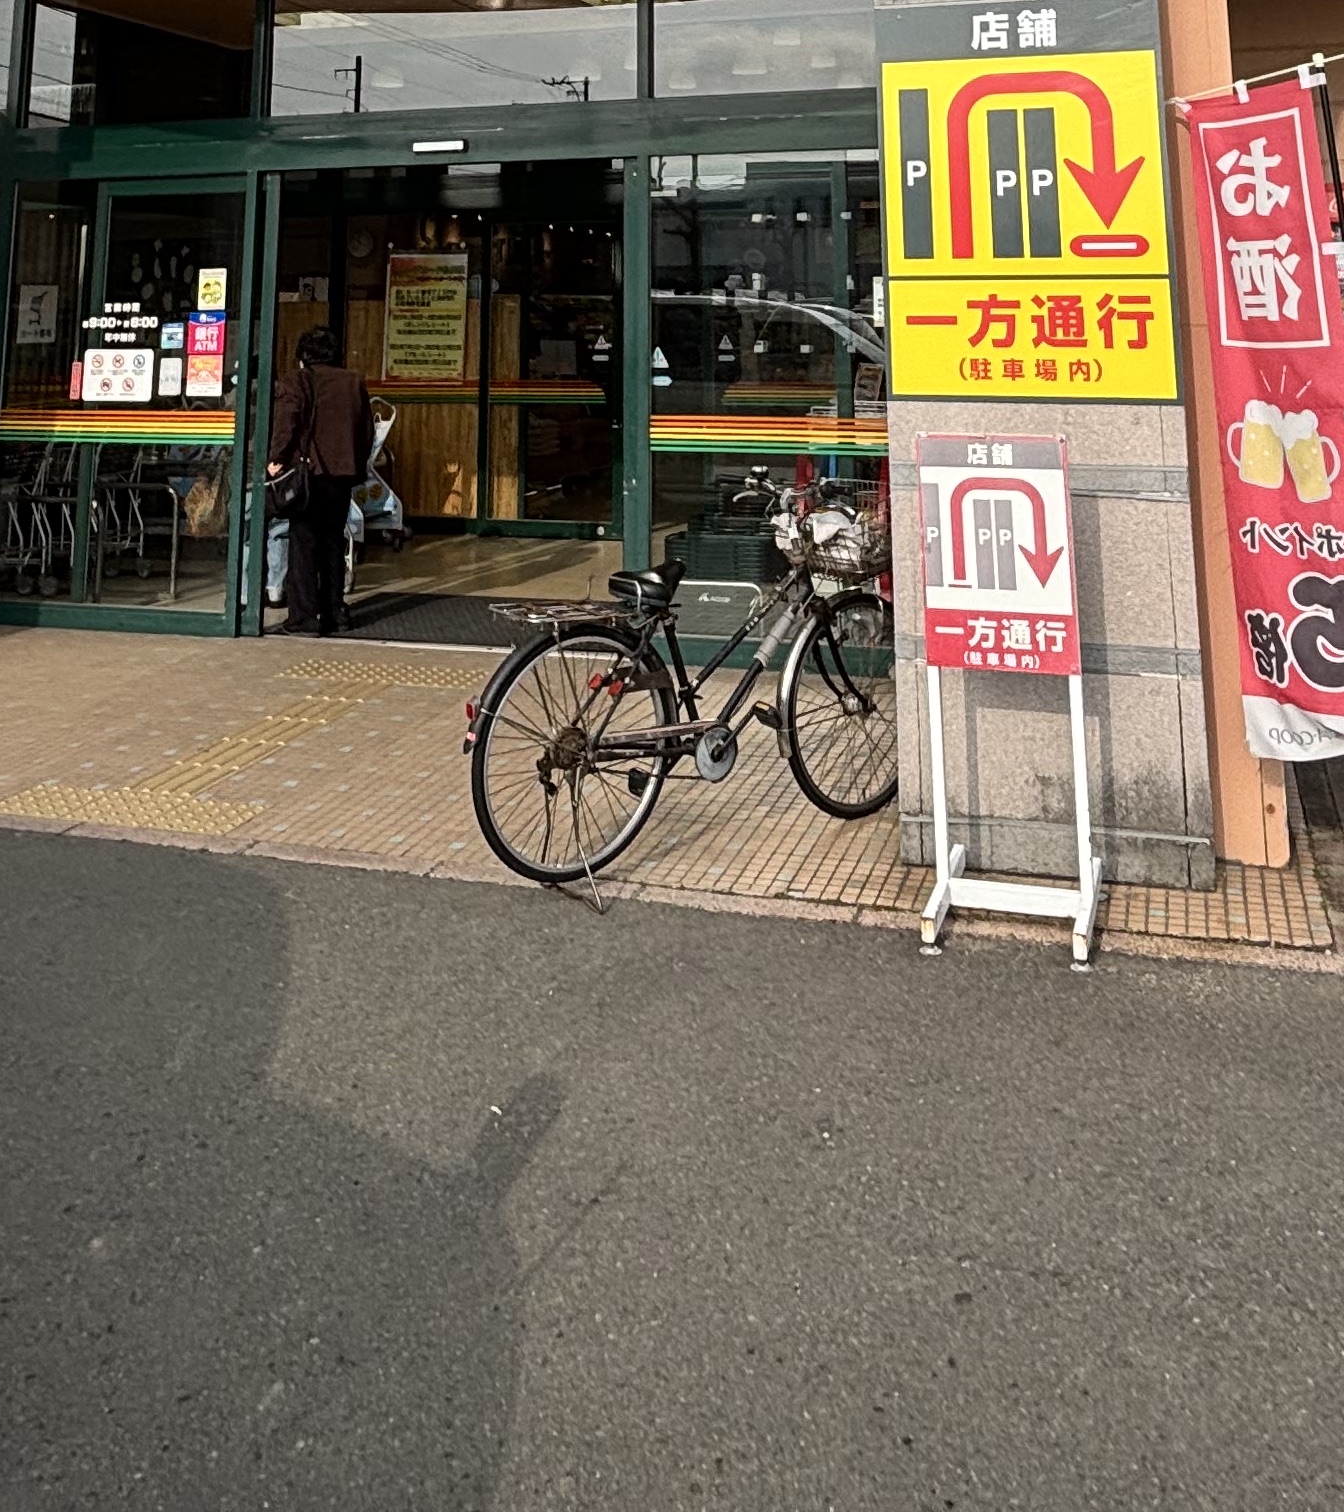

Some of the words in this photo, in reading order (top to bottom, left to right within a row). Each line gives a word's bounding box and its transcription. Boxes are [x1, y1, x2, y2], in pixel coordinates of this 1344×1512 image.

[970, 8, 1058, 51] 店舗
[906, 160, 928, 186] P
[996, 170, 1018, 196] P
[1031, 169, 1054, 195] P
[906, 293, 1155, 350] 一方通行
[193, 340, 219, 352] ATM
[966, 442, 1013, 467] 店舗
[926, 526, 940, 544] P
[978, 528, 992, 546] P
[998, 529, 1012, 546] P
[934, 616, 1068, 653] 一方通行
